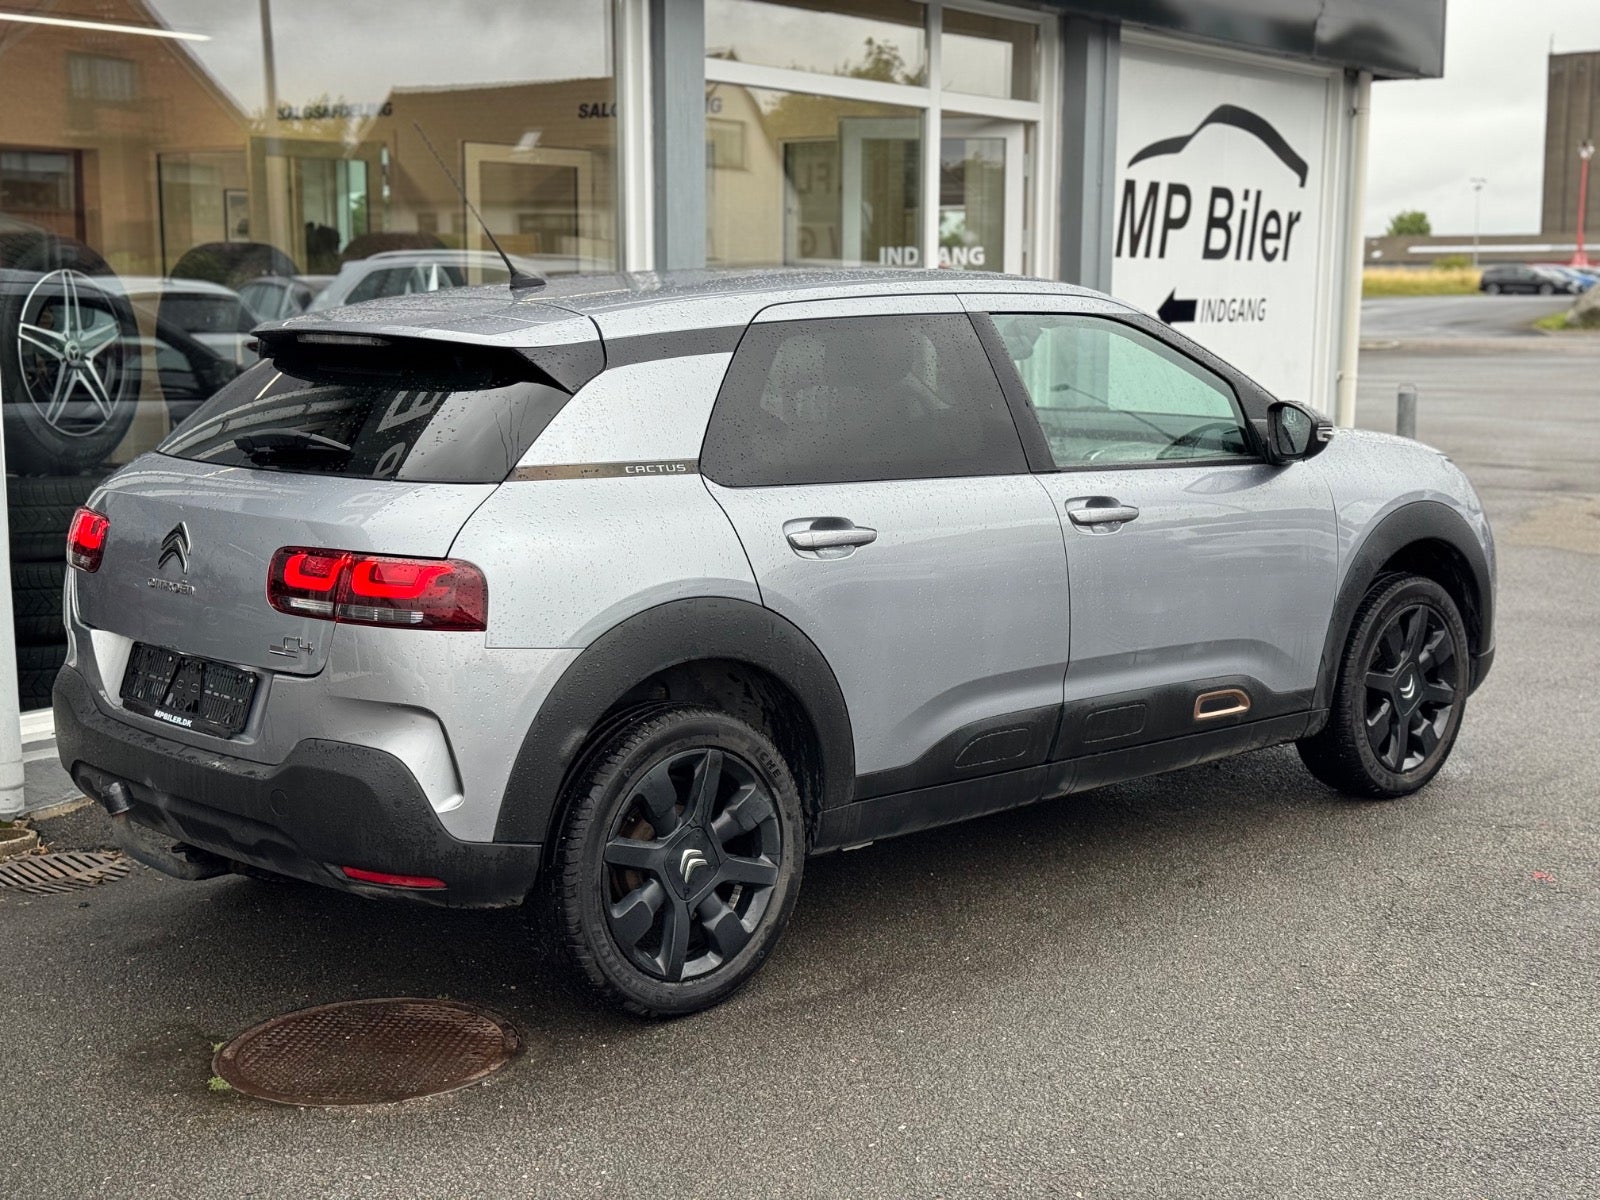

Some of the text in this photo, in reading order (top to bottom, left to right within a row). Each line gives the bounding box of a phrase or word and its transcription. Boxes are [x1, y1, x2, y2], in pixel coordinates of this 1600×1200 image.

[1115, 179, 1302, 262] MP Biler
[879, 246, 985, 266] INDANG
[1200, 298, 1267, 323] INDGANG
[625, 463, 687, 474] CACTUS
[153, 709, 193, 728] MPBILER.DK
